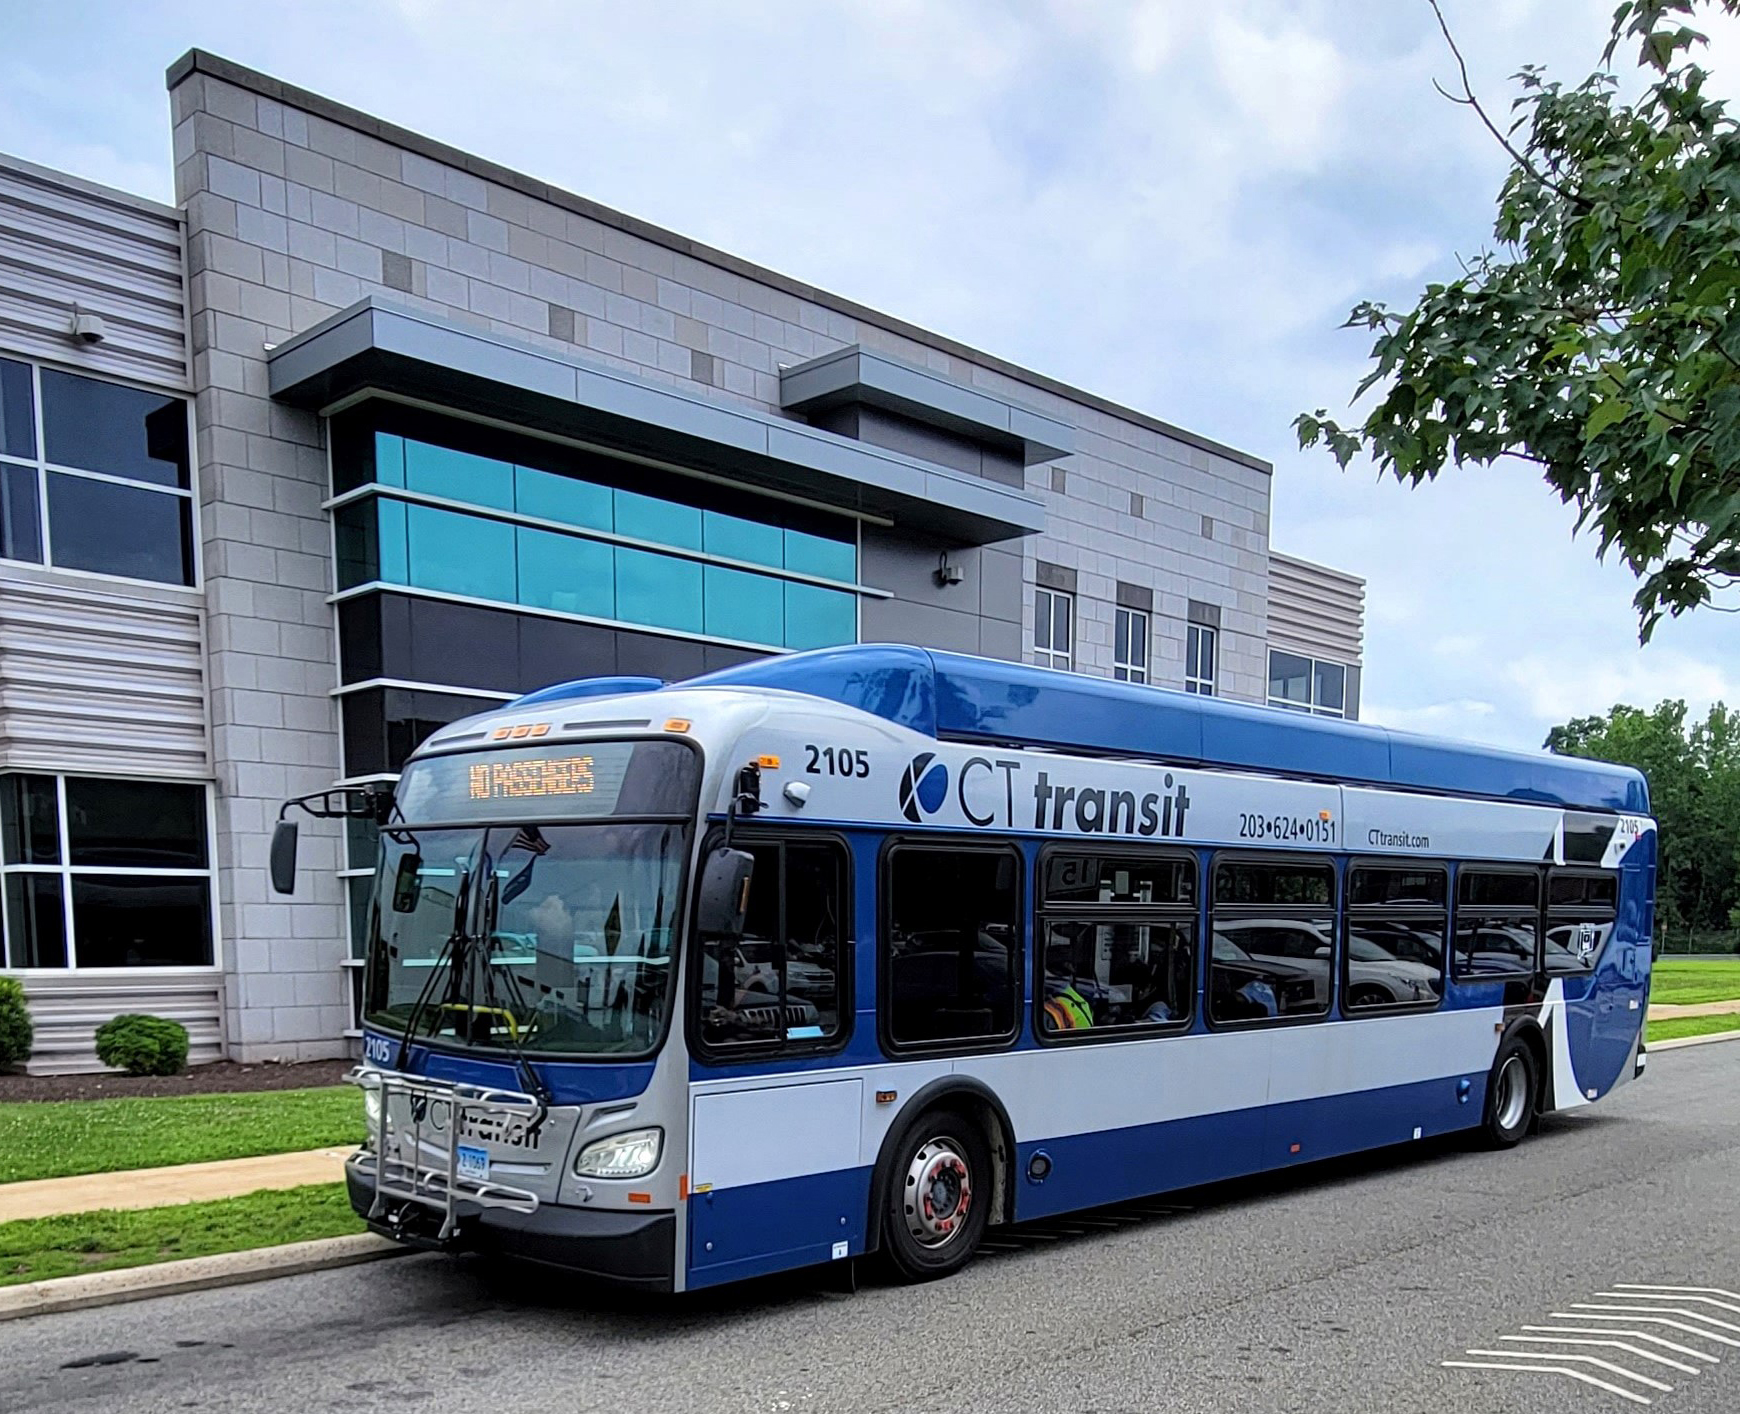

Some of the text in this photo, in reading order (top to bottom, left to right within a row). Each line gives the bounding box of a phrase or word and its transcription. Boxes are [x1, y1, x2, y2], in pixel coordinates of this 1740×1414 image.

[805, 744, 870, 778] 2105
[958, 757, 1190, 838] CT transit
[1368, 829, 1430, 848] CTtransit.com
[1620, 818, 1639, 834] 2105
[365, 1036, 390, 1062] 2105
